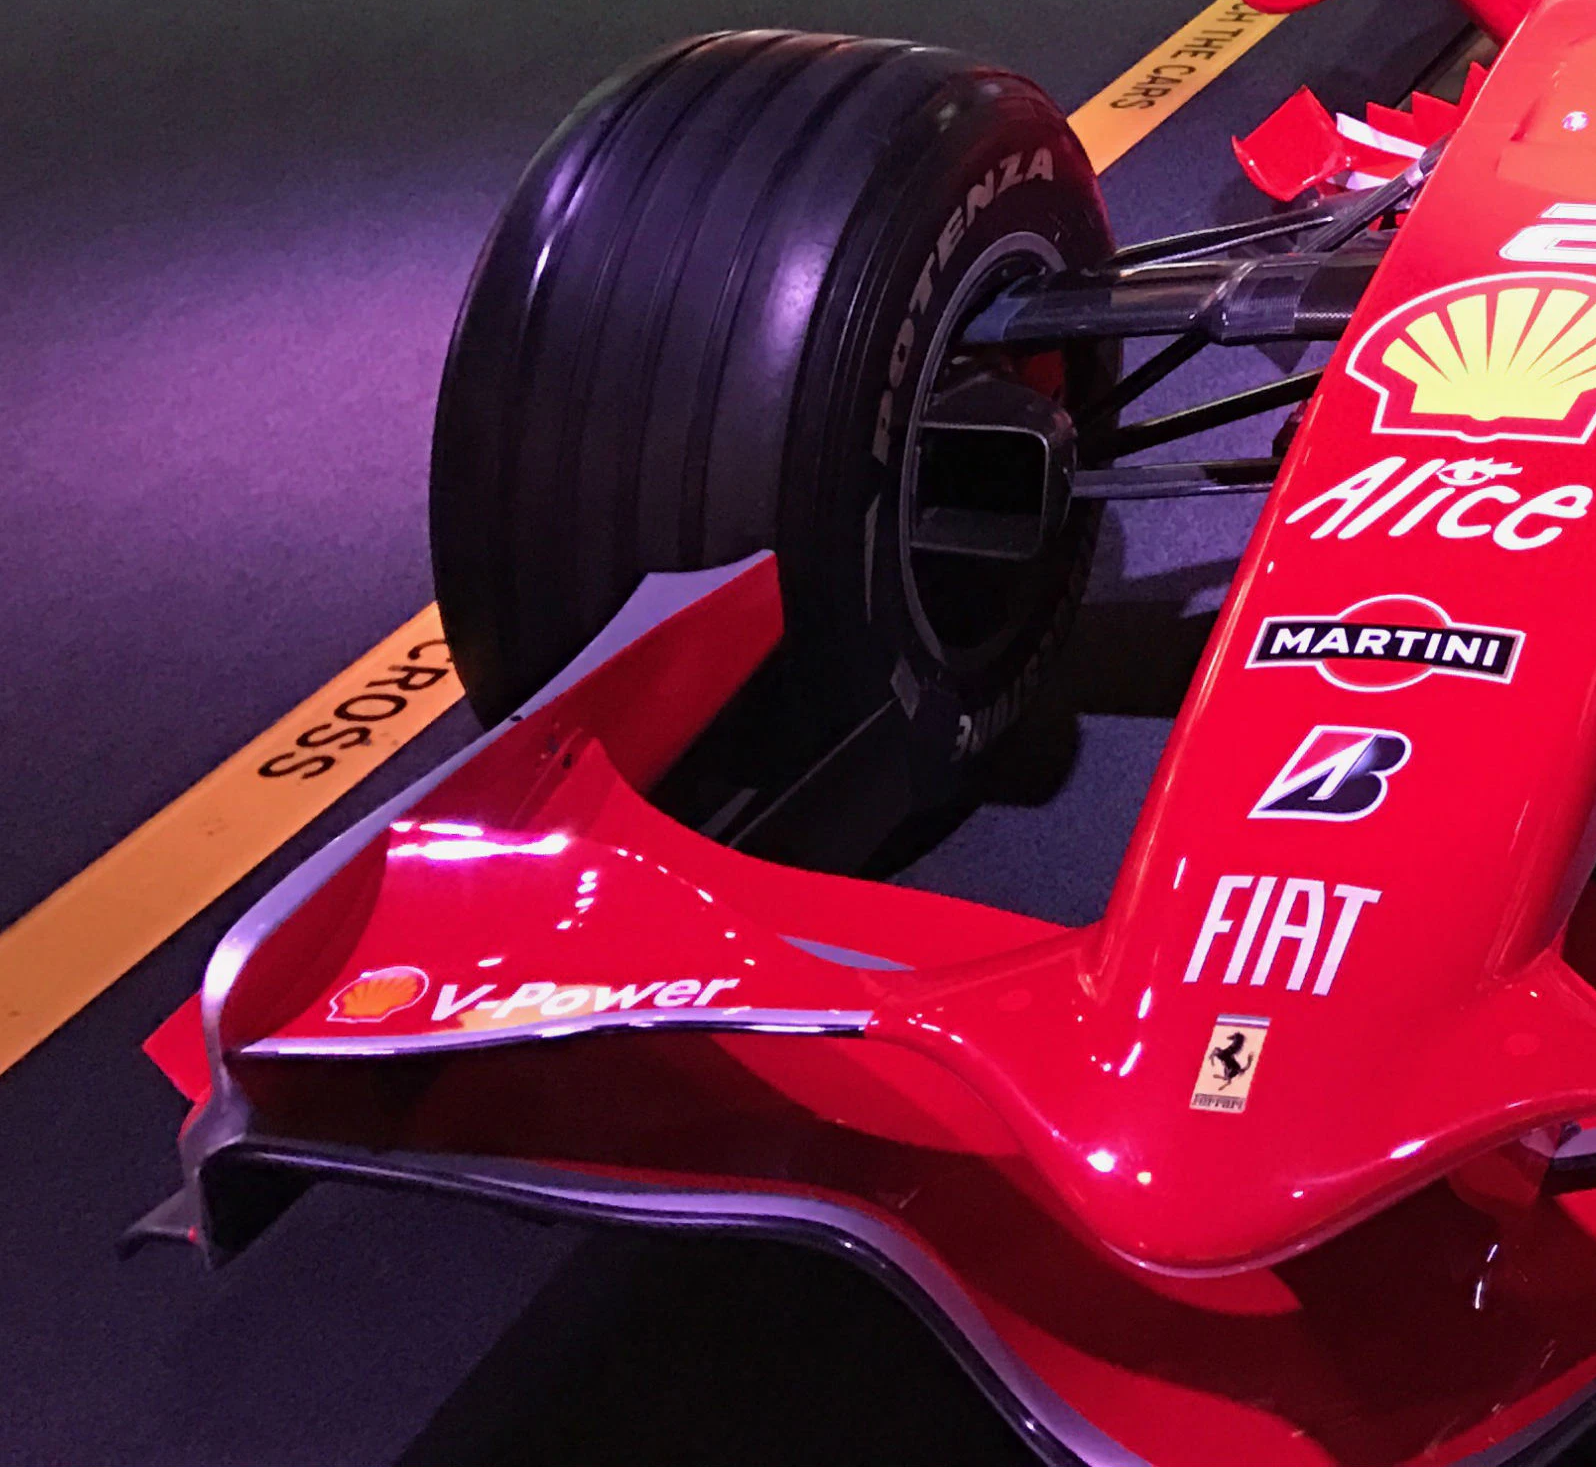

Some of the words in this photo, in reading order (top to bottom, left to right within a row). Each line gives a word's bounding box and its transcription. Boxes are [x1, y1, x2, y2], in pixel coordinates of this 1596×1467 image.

[1171, 28, 1244, 61] THE
[1109, 63, 1197, 110] CARS
[871, 146, 1054, 466] POTENZA
[1286, 455, 1593, 551] Alice
[1269, 627, 1500, 667] MARTINI
[257, 638, 452, 780] CROSS
[1182, 874, 1383, 997] FIAT
[430, 978, 741, 1022] V-Power
